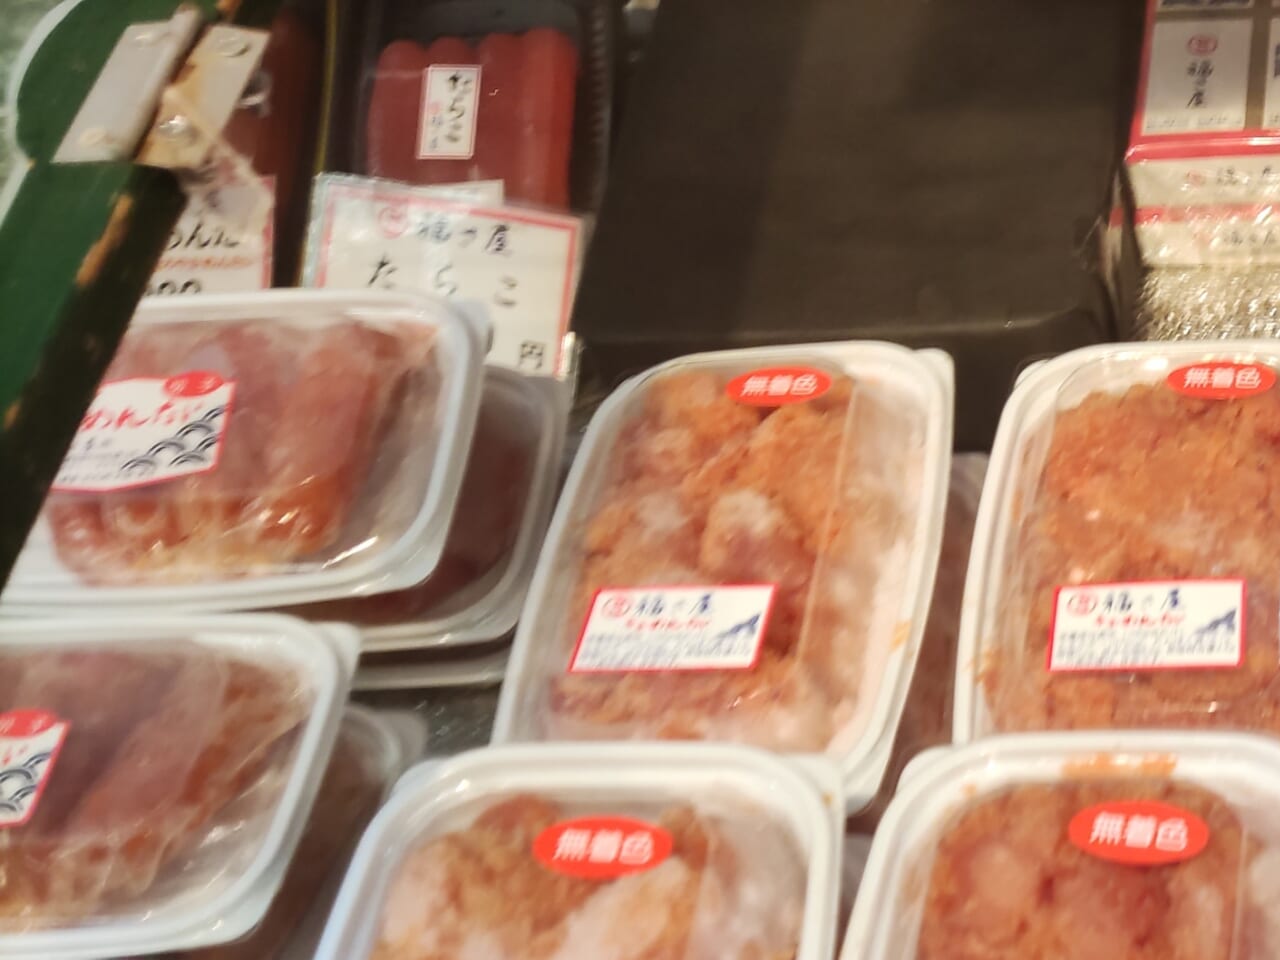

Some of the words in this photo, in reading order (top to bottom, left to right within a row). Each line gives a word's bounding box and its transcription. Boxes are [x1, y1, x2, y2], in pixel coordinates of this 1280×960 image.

[446, 71, 473, 143] たらこ
[367, 254, 519, 309] たらこ
[519, 340, 545, 370] 円
[741, 373, 819, 397] 無着色
[1183, 366, 1263, 389] 無着色
[635, 592, 714, 616] 福さ屋
[1104, 587, 1182, 615] 福さ屋
[551, 828, 654, 865] 無着色
[1088, 812, 1190, 851] 無着色
